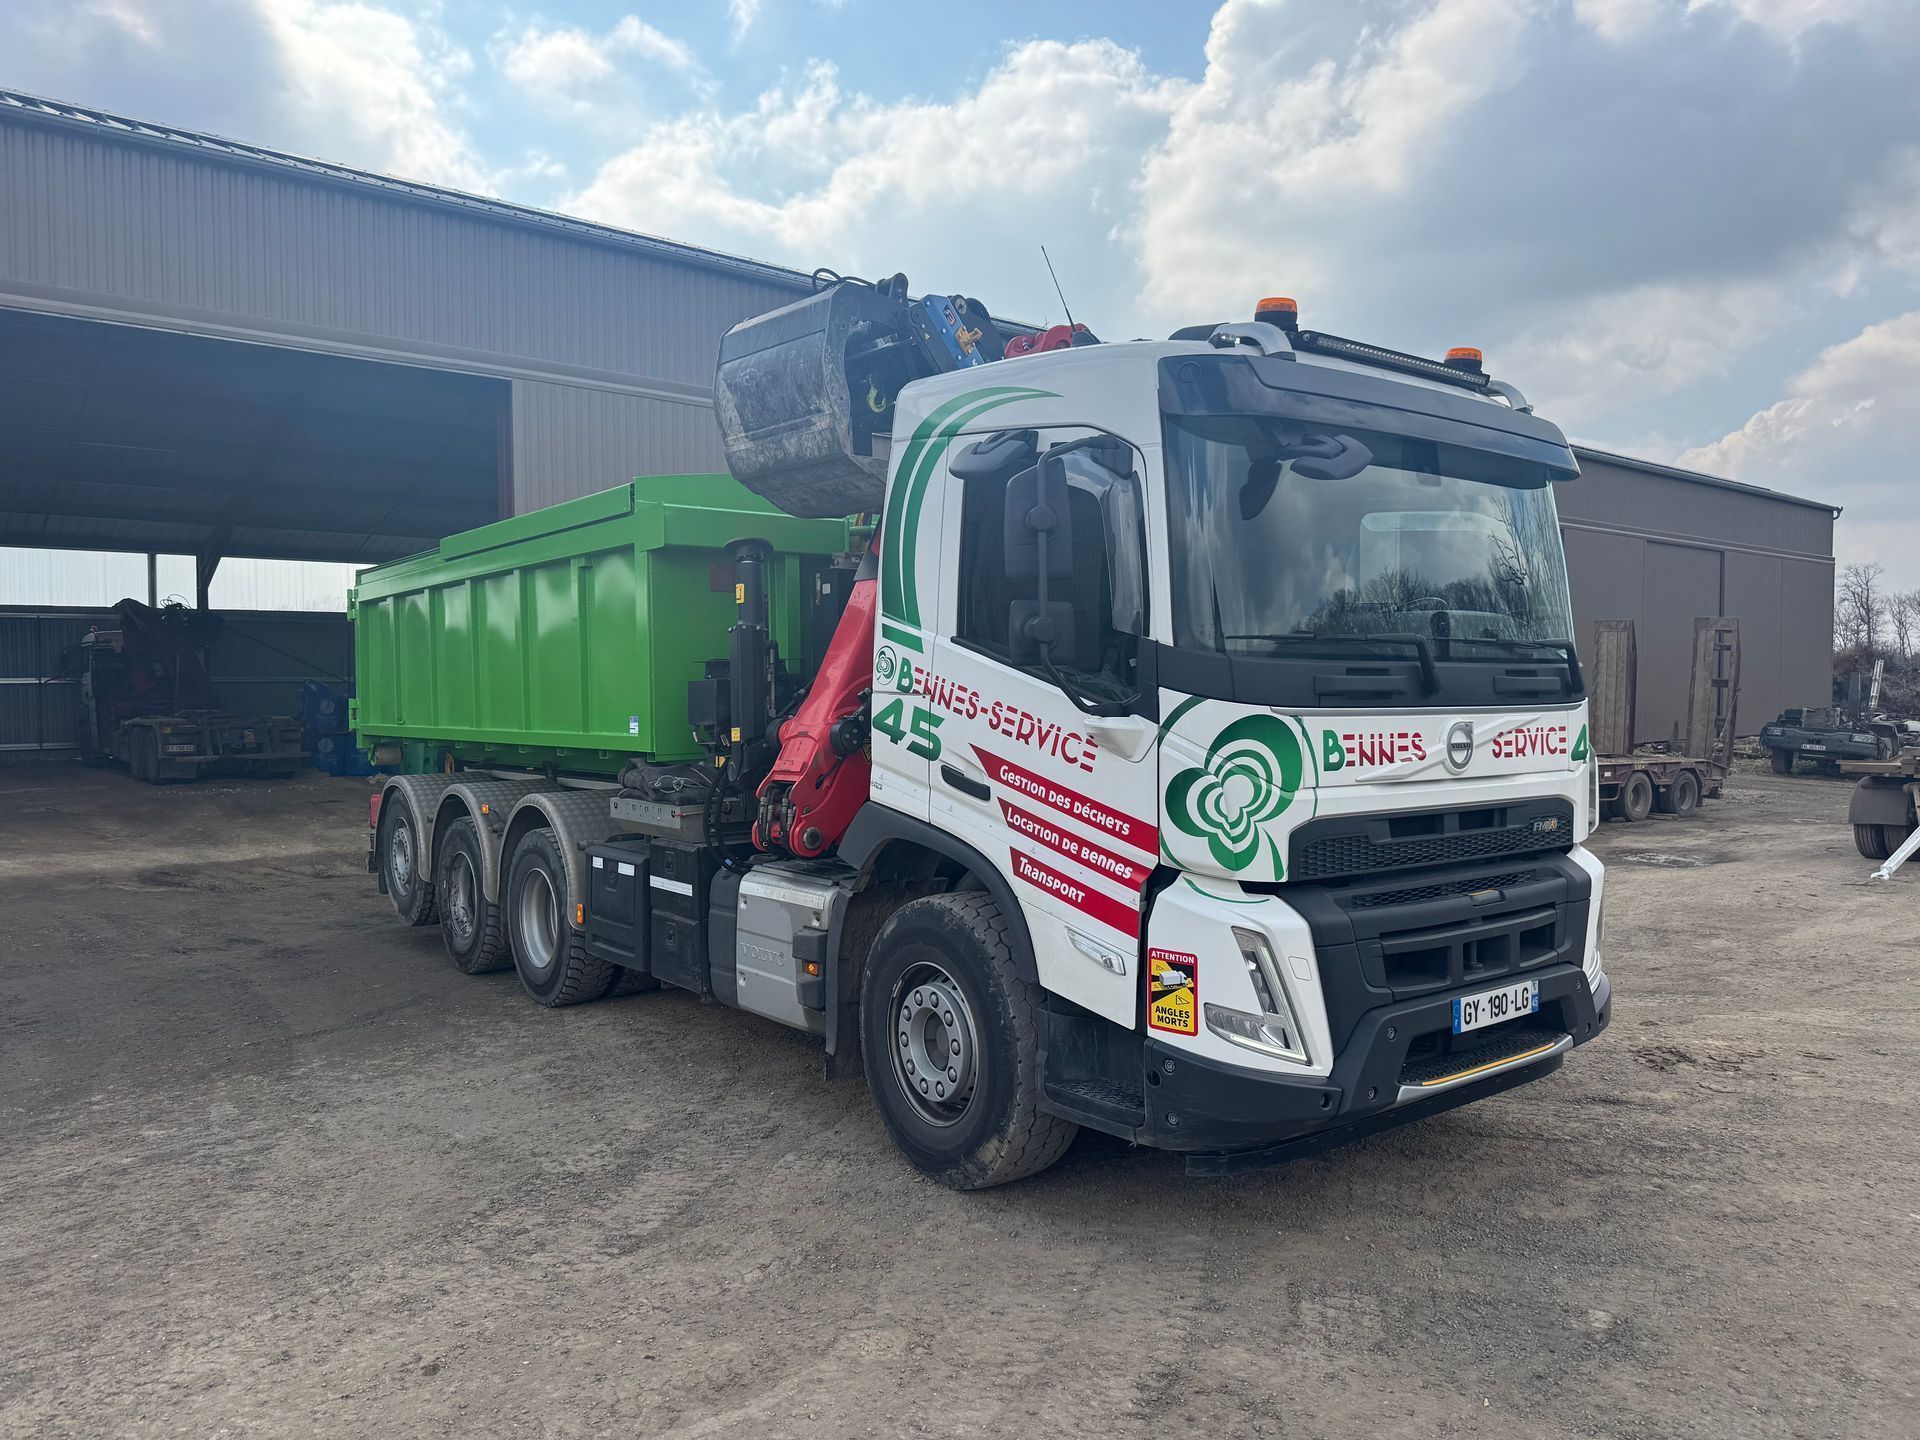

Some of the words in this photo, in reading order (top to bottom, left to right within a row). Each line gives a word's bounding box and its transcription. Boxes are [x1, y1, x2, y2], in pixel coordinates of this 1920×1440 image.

[872, 698, 945, 761] 45
[1323, 729, 1427, 771] BENNES
[1492, 726, 1567, 758] SERVICE
[1450, 742, 1471, 750] VOLVO
[1151, 950, 1194, 964] ATTENTION
[1155, 1005, 1190, 1019] ANGLES
[1157, 1014, 1188, 1027] MORTS
